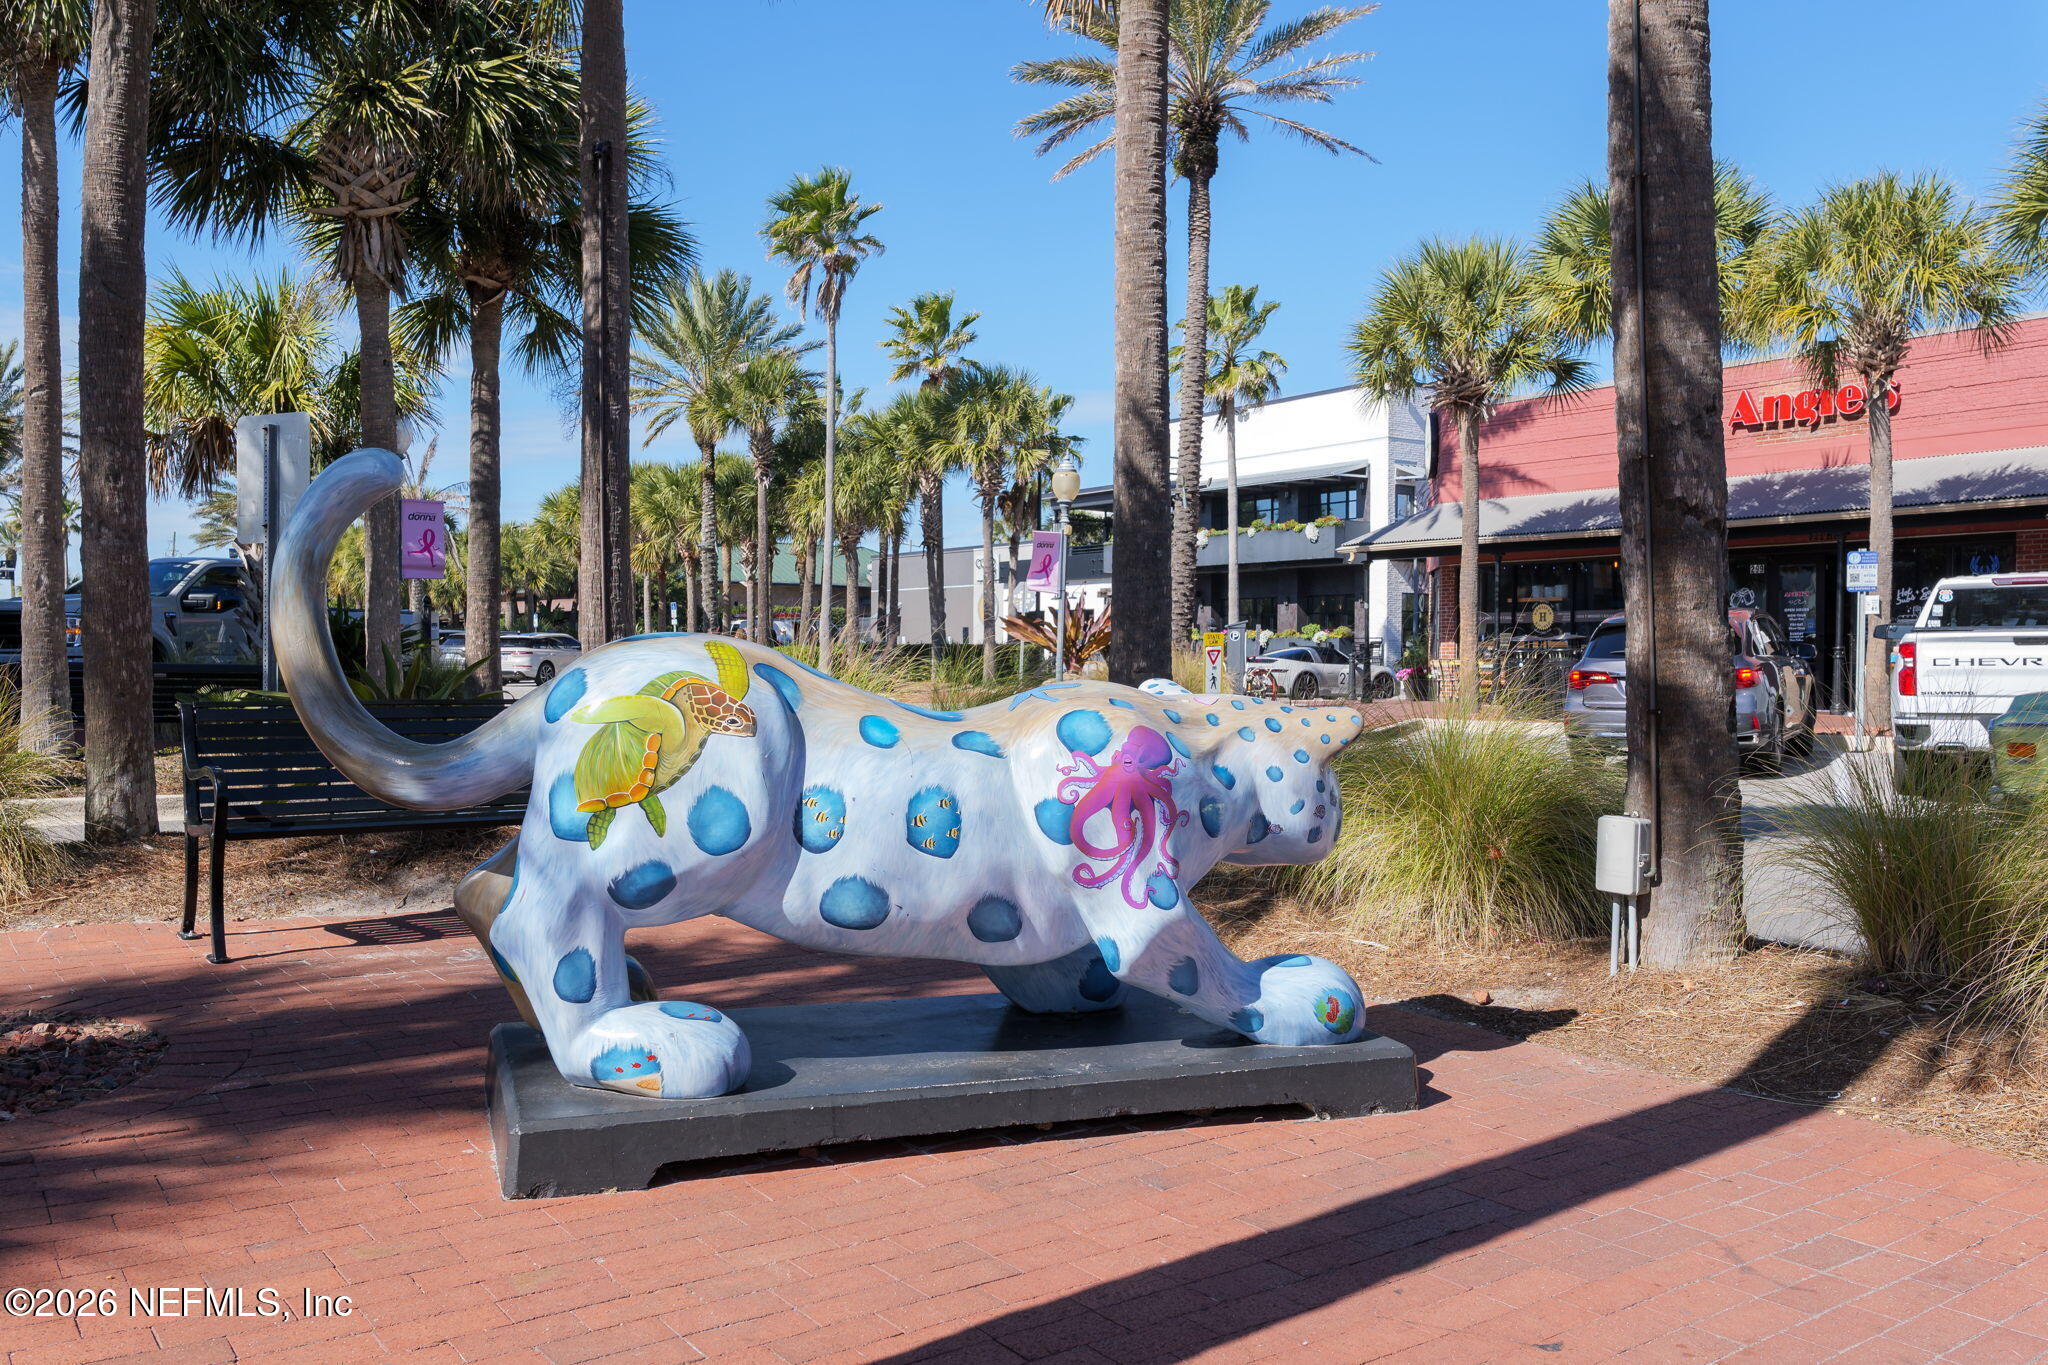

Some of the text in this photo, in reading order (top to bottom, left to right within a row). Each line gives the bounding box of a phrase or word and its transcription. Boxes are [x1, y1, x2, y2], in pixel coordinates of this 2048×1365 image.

[408, 512, 436, 521] donna
[1933, 657, 2043, 666] CHEVR
[1339, 672, 1349, 684] 2
